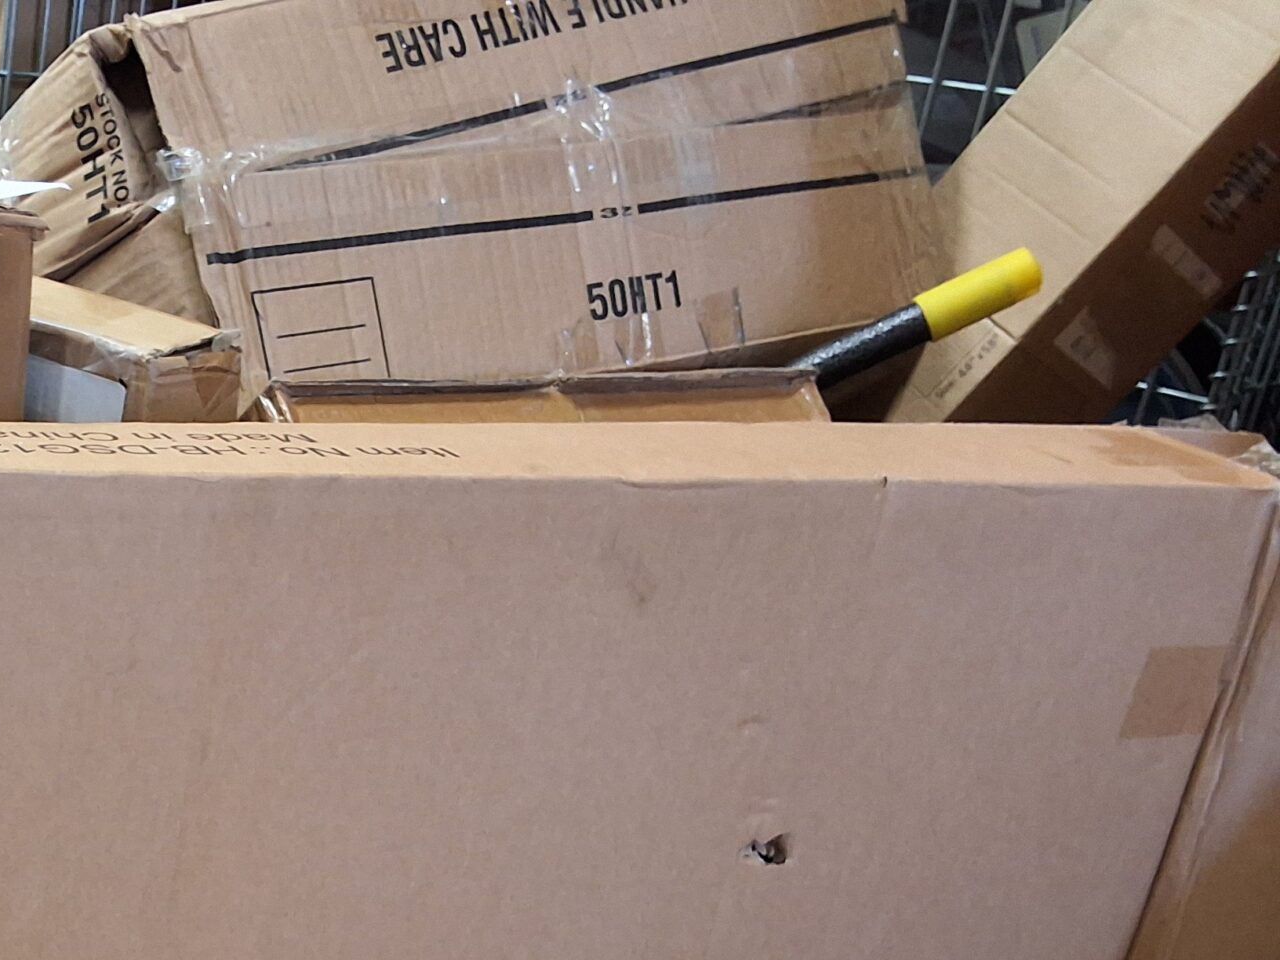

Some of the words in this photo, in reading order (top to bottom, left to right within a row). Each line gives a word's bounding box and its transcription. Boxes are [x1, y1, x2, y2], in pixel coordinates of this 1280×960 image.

[375, 19, 467, 73] CARE
[470, 0, 562, 51] WITH
[95, 92, 124, 166] STOCK
[71, 103, 110, 223] 50HT1
[586, 270, 682, 321] 50HT1
[132, 431, 176, 443] in
[186, 432, 319, 444] Made
[355, 446, 461, 459] Item
